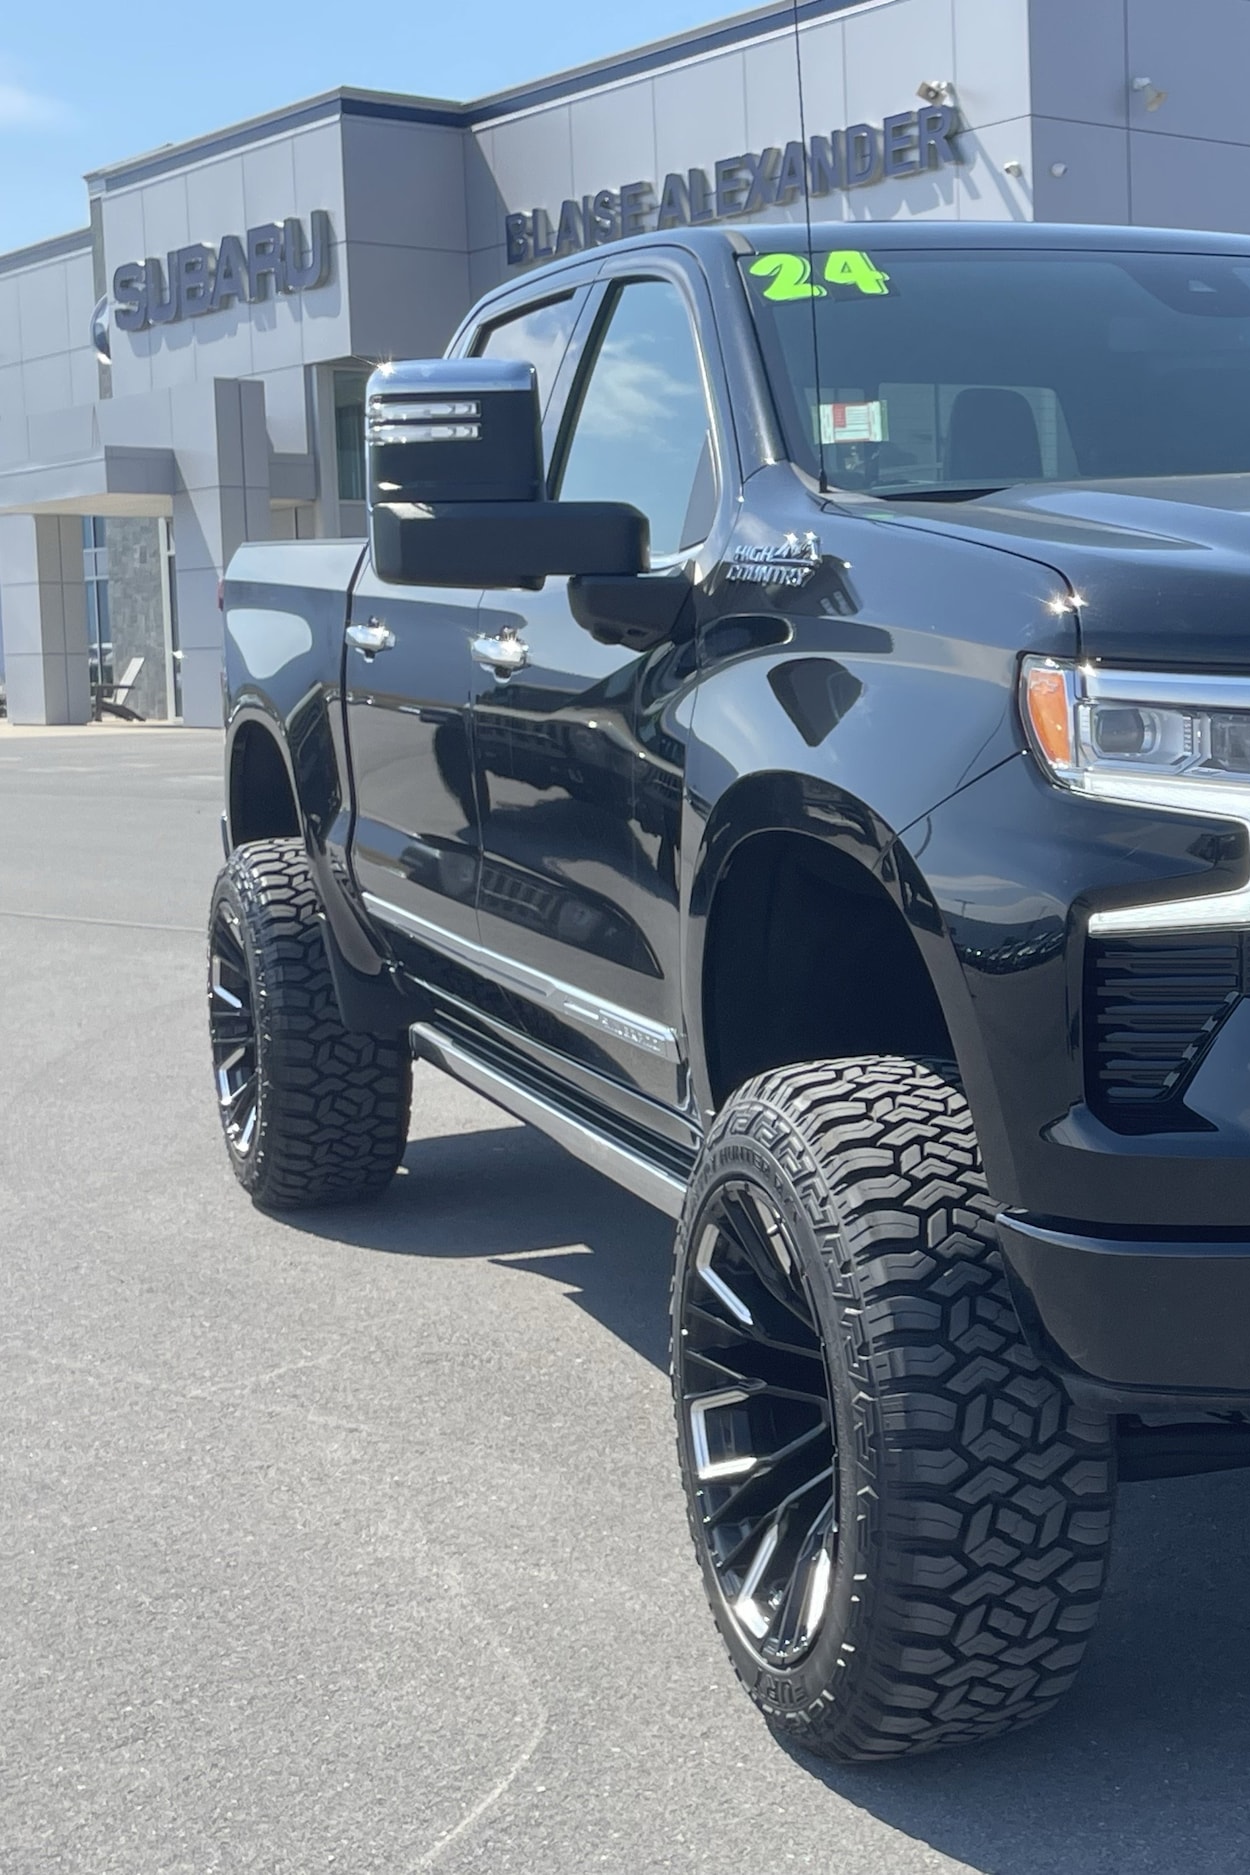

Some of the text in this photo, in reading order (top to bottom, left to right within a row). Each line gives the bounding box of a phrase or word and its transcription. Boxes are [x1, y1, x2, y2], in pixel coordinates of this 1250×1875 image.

[505, 104, 963, 265] BLAISE ALEXANDER
[113, 209, 331, 332] SUBARU
[750, 250, 890, 301] 24
[734, 545, 775, 561] HIGH
